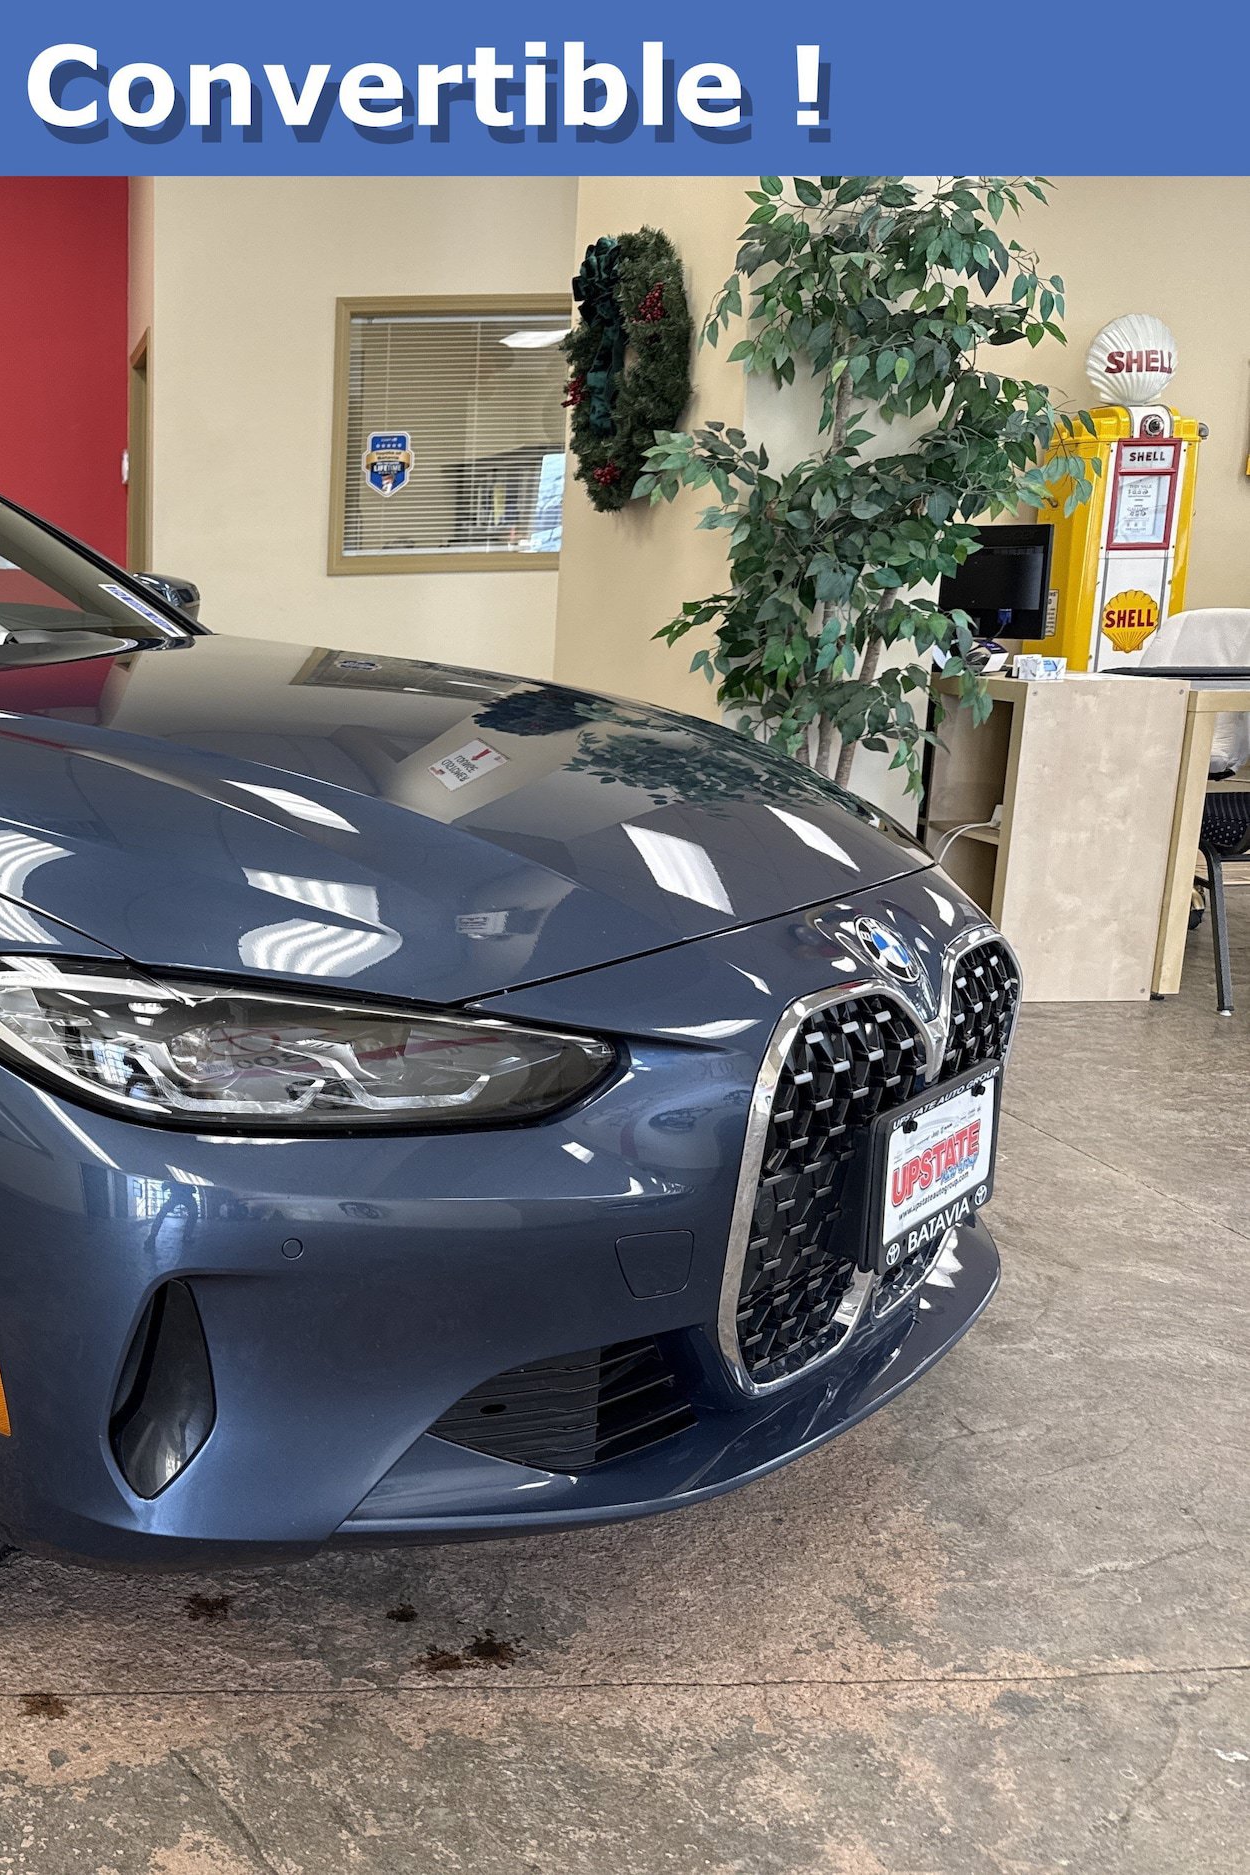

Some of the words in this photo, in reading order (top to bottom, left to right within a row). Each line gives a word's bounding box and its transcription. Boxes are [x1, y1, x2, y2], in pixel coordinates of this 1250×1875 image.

[1104, 349, 1173, 374] SHELL
[1128, 451, 1166, 462] SHELL
[1104, 608, 1155, 629] SHELL
[892, 1099, 938, 1131] UPSTATE
[937, 1085, 966, 1105] AUTO
[965, 1065, 1000, 1090] GROUP
[890, 1117, 982, 1208] UPSTATE
[907, 1196, 971, 1253] BATAVIA
